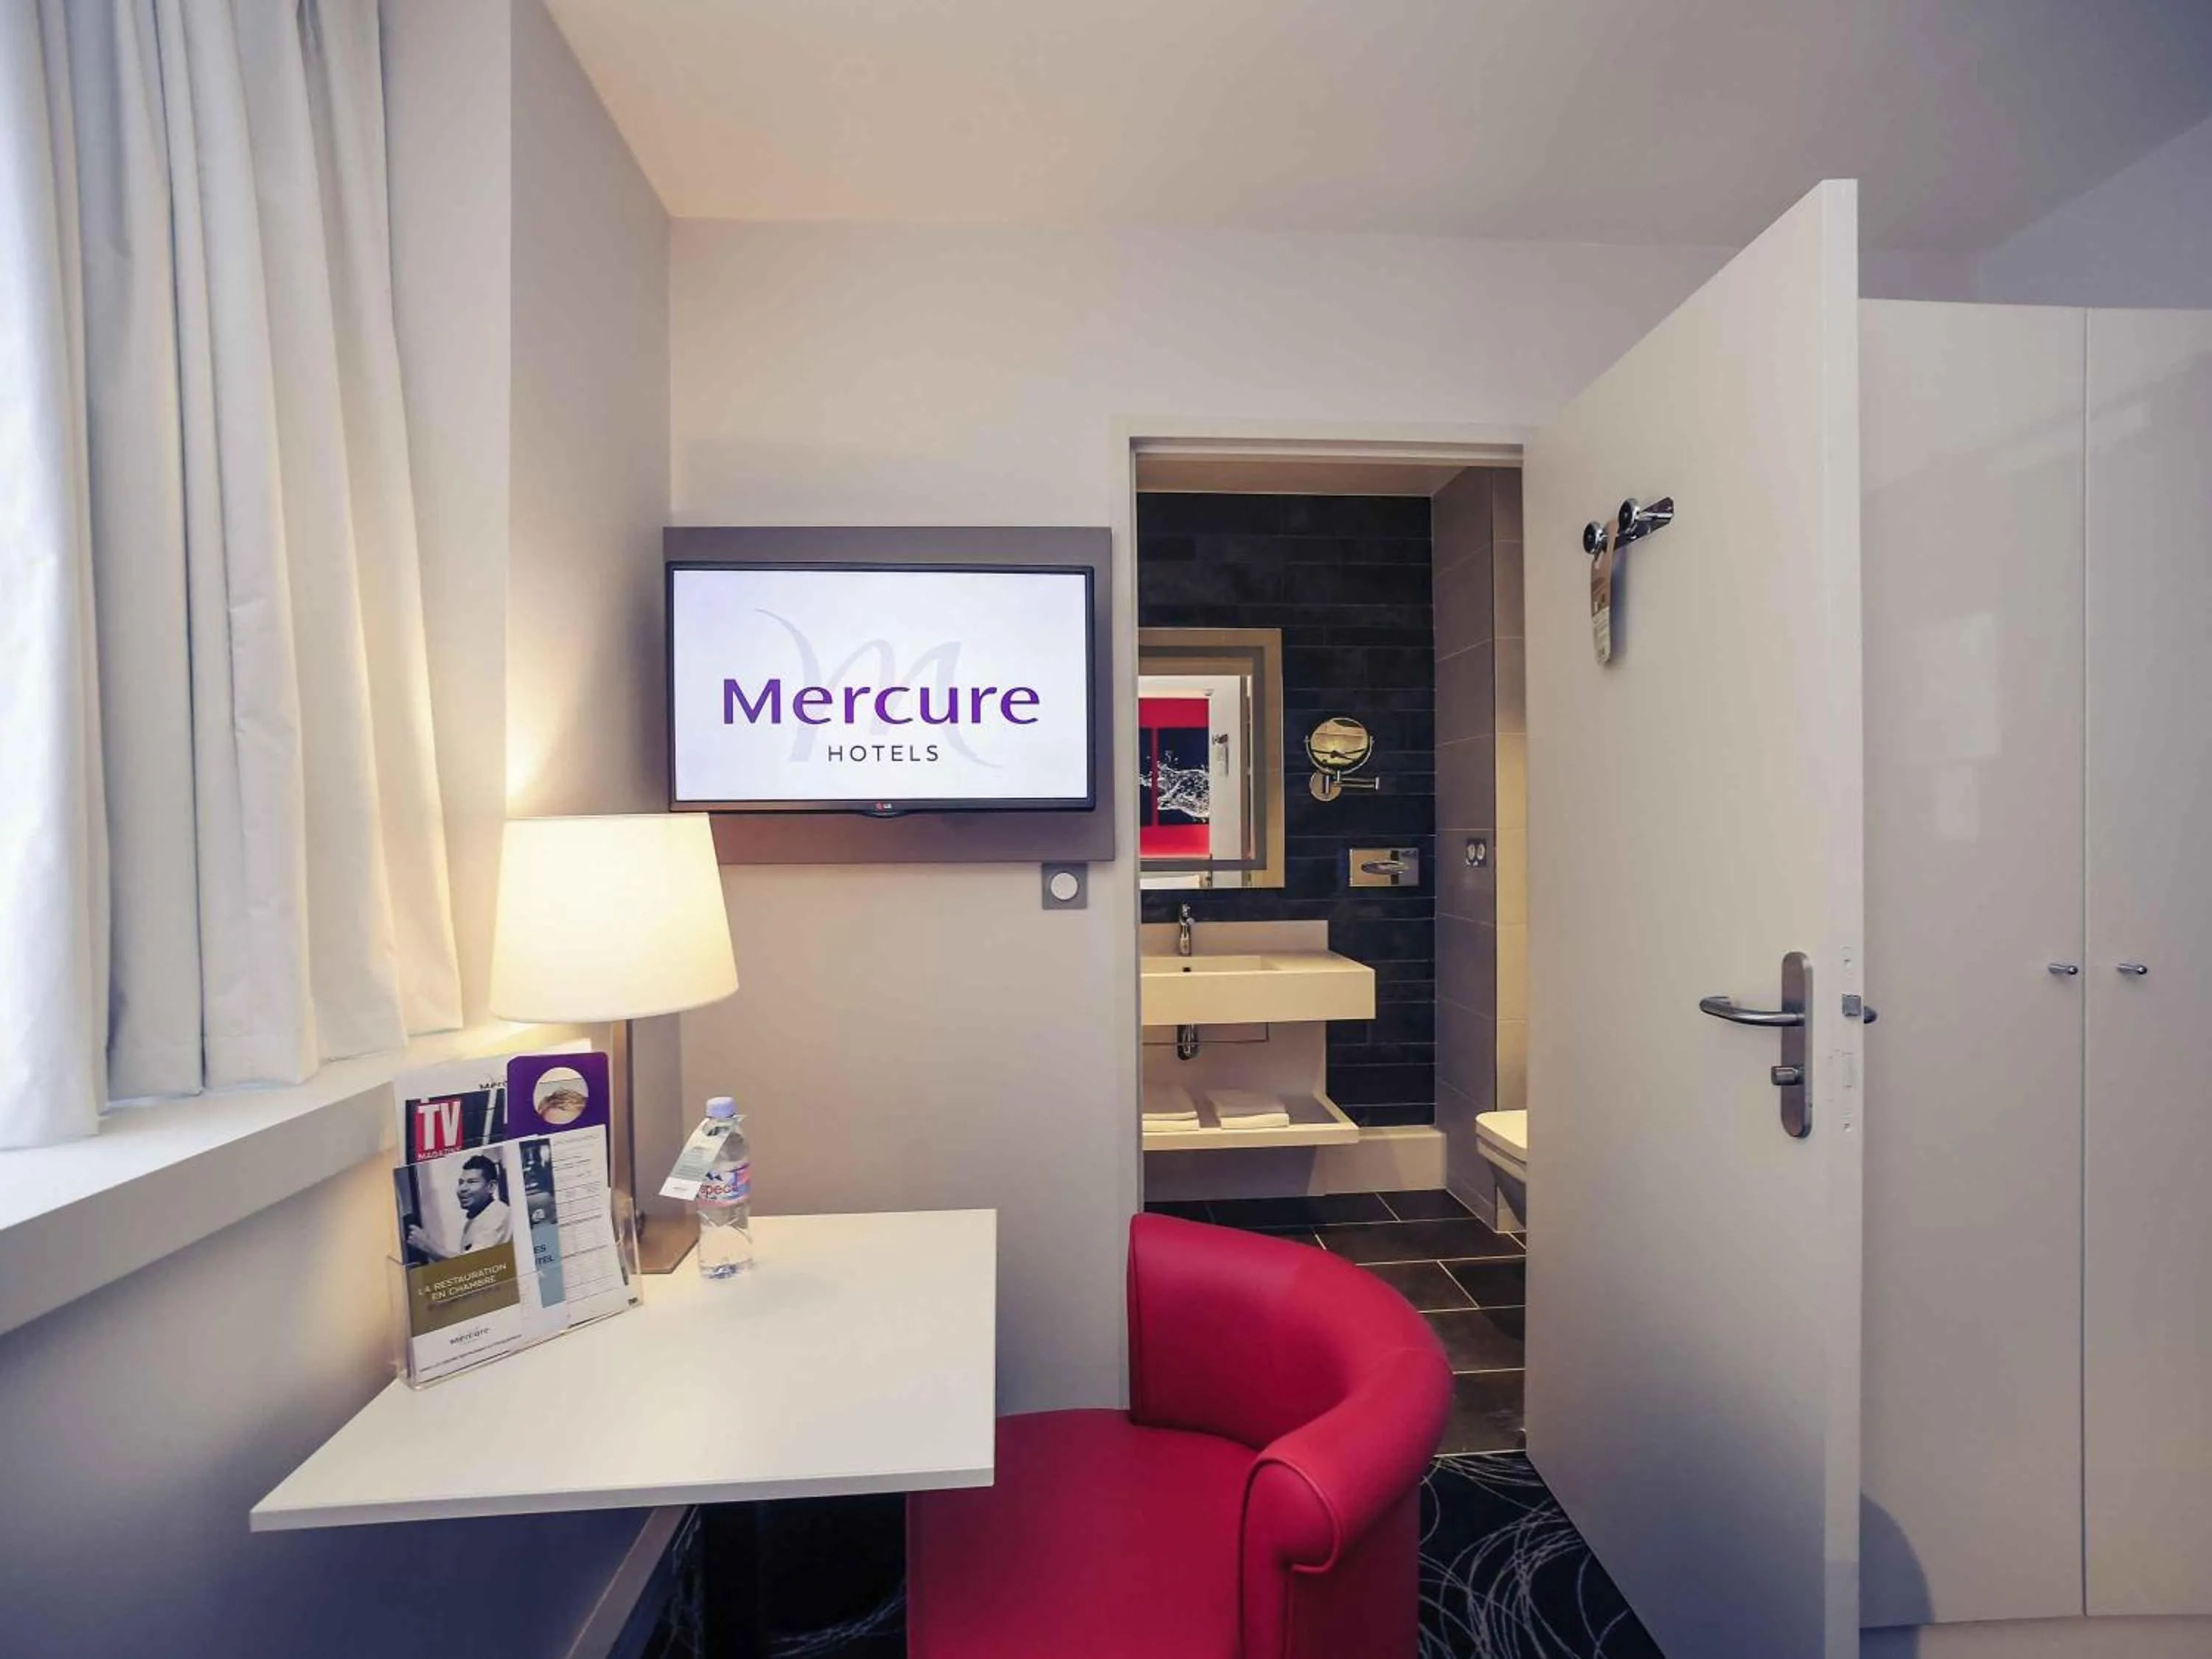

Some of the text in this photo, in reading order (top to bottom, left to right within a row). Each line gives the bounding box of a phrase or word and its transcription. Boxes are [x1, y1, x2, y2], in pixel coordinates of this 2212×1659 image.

[723, 678, 1040, 725] Mercure
[827, 745, 940, 762] HOTELS
[417, 1100, 461, 1151] TV
[431, 1275, 496, 1301] EN CHAMBRE
[434, 1262, 507, 1292] RESTAURATION
